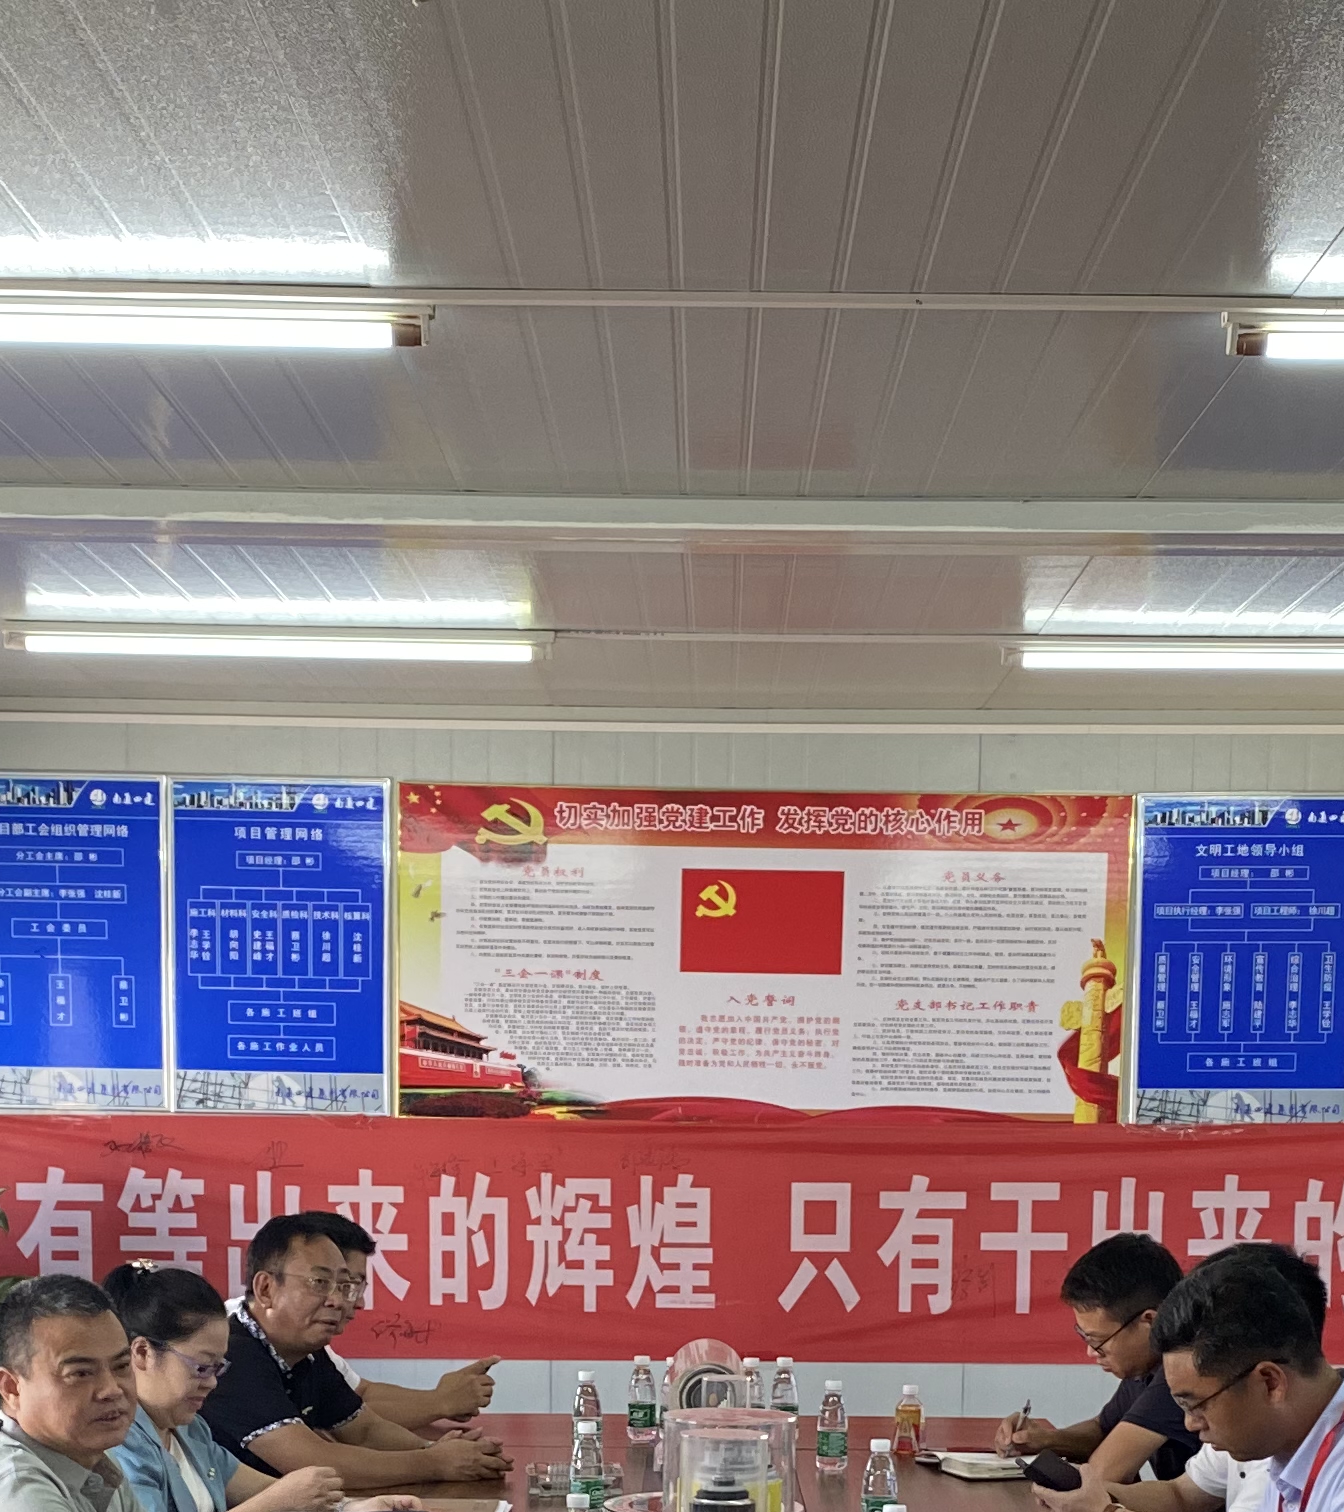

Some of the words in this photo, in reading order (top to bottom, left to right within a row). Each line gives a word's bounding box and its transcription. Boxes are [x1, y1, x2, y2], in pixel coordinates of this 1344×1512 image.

[554, 802, 764, 832] 切实加强党建工作
[775, 805, 986, 836] 发挥党的核心作用
[234, 826, 323, 841] 项目管理网络
[1195, 843, 1304, 857] 文明工地领导小组
[30, 923, 87, 933] 工会委员
[727, 993, 795, 1007] 入党誓词
[895, 998, 1040, 1013] 党支部书记工作职责
[237, 1041, 325, 1053] 各施工作业人员
